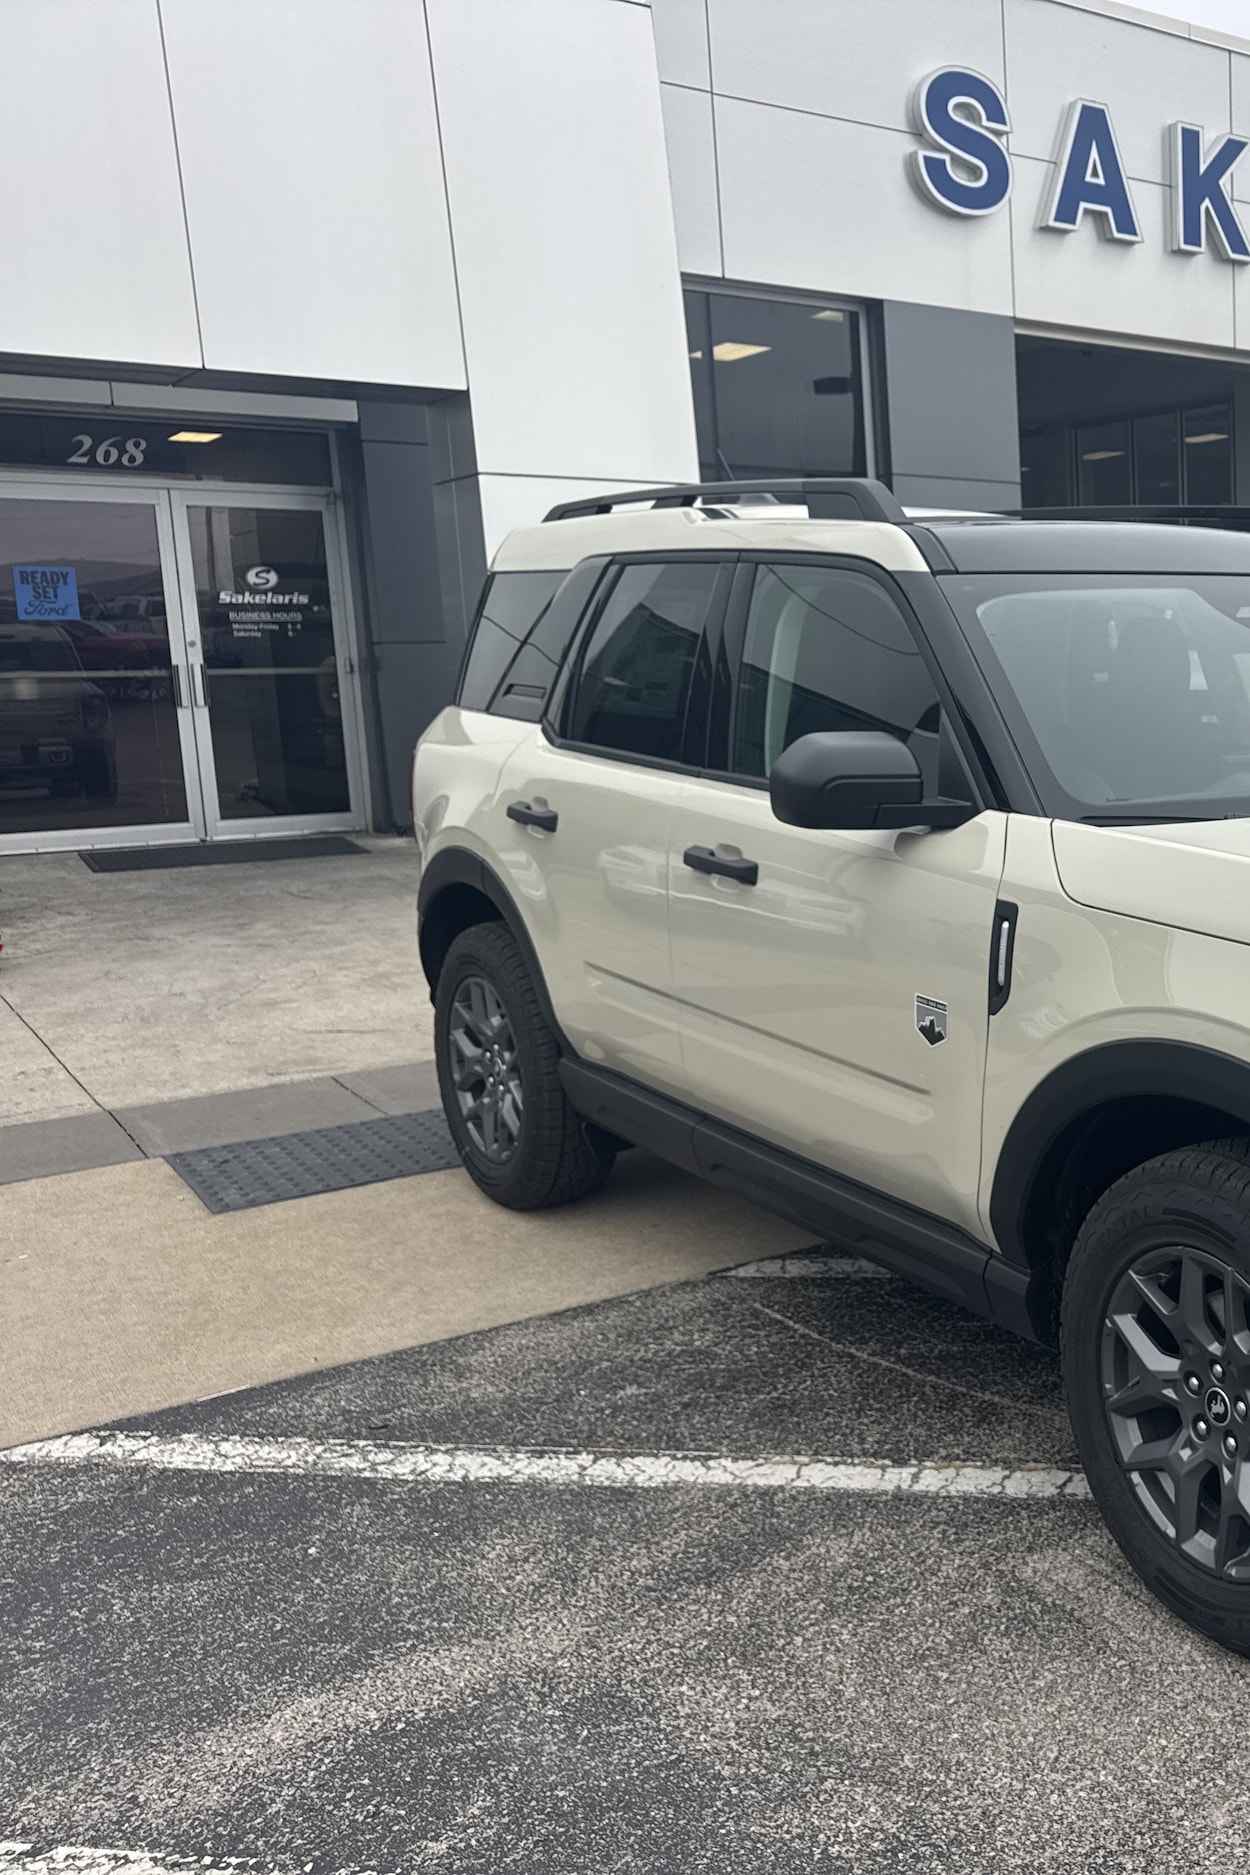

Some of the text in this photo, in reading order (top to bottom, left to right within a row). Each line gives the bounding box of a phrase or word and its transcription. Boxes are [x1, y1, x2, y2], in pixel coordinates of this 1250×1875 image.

[67, 434, 147, 467] 268
[19, 570, 69, 586] READY
[32, 585, 59, 600] SET
[218, 591, 309, 604] Sakelaris
[24, 599, 72, 617] Ford
[229, 611, 302, 621] BUSINESS HOURS
